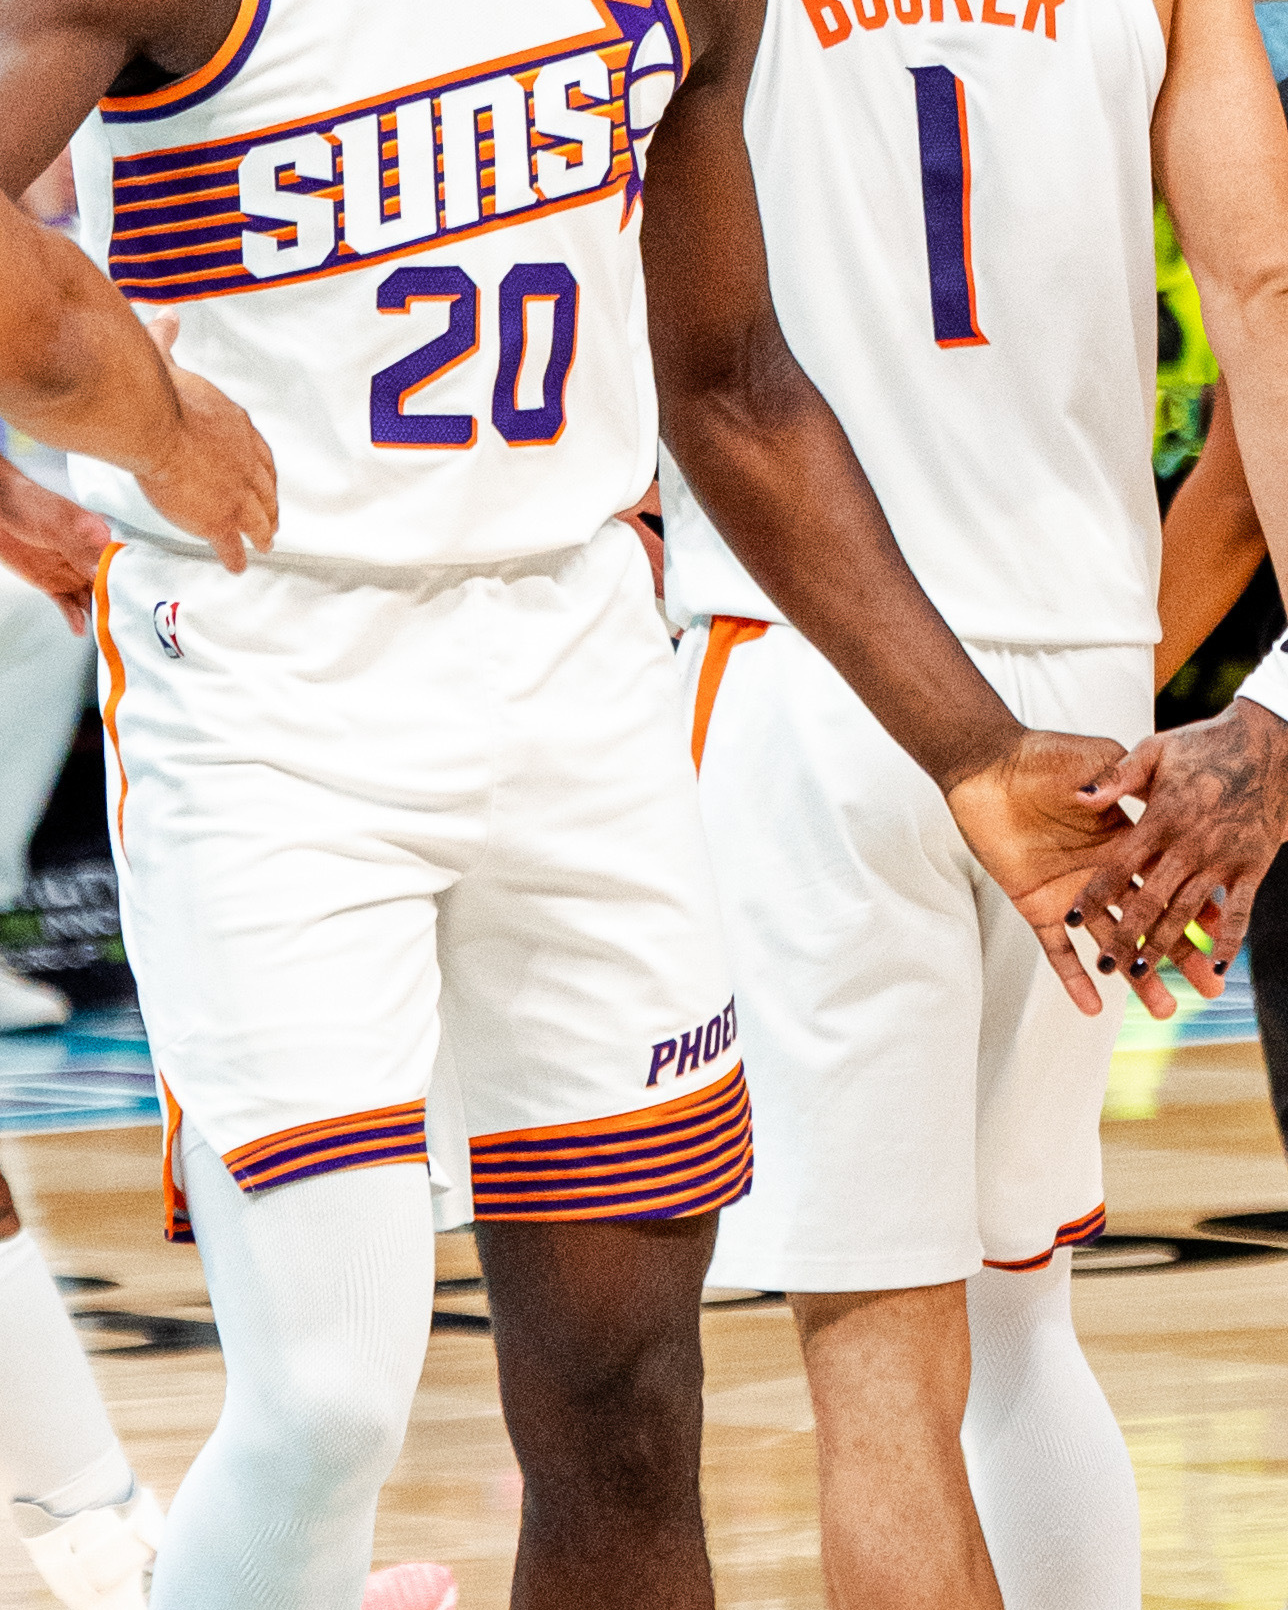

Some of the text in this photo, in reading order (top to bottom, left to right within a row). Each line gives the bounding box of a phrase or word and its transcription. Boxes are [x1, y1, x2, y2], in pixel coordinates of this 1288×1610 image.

[905, 64, 991, 350] 1
[369, 262, 580, 450] 20
[645, 992, 738, 1089] PHOE
